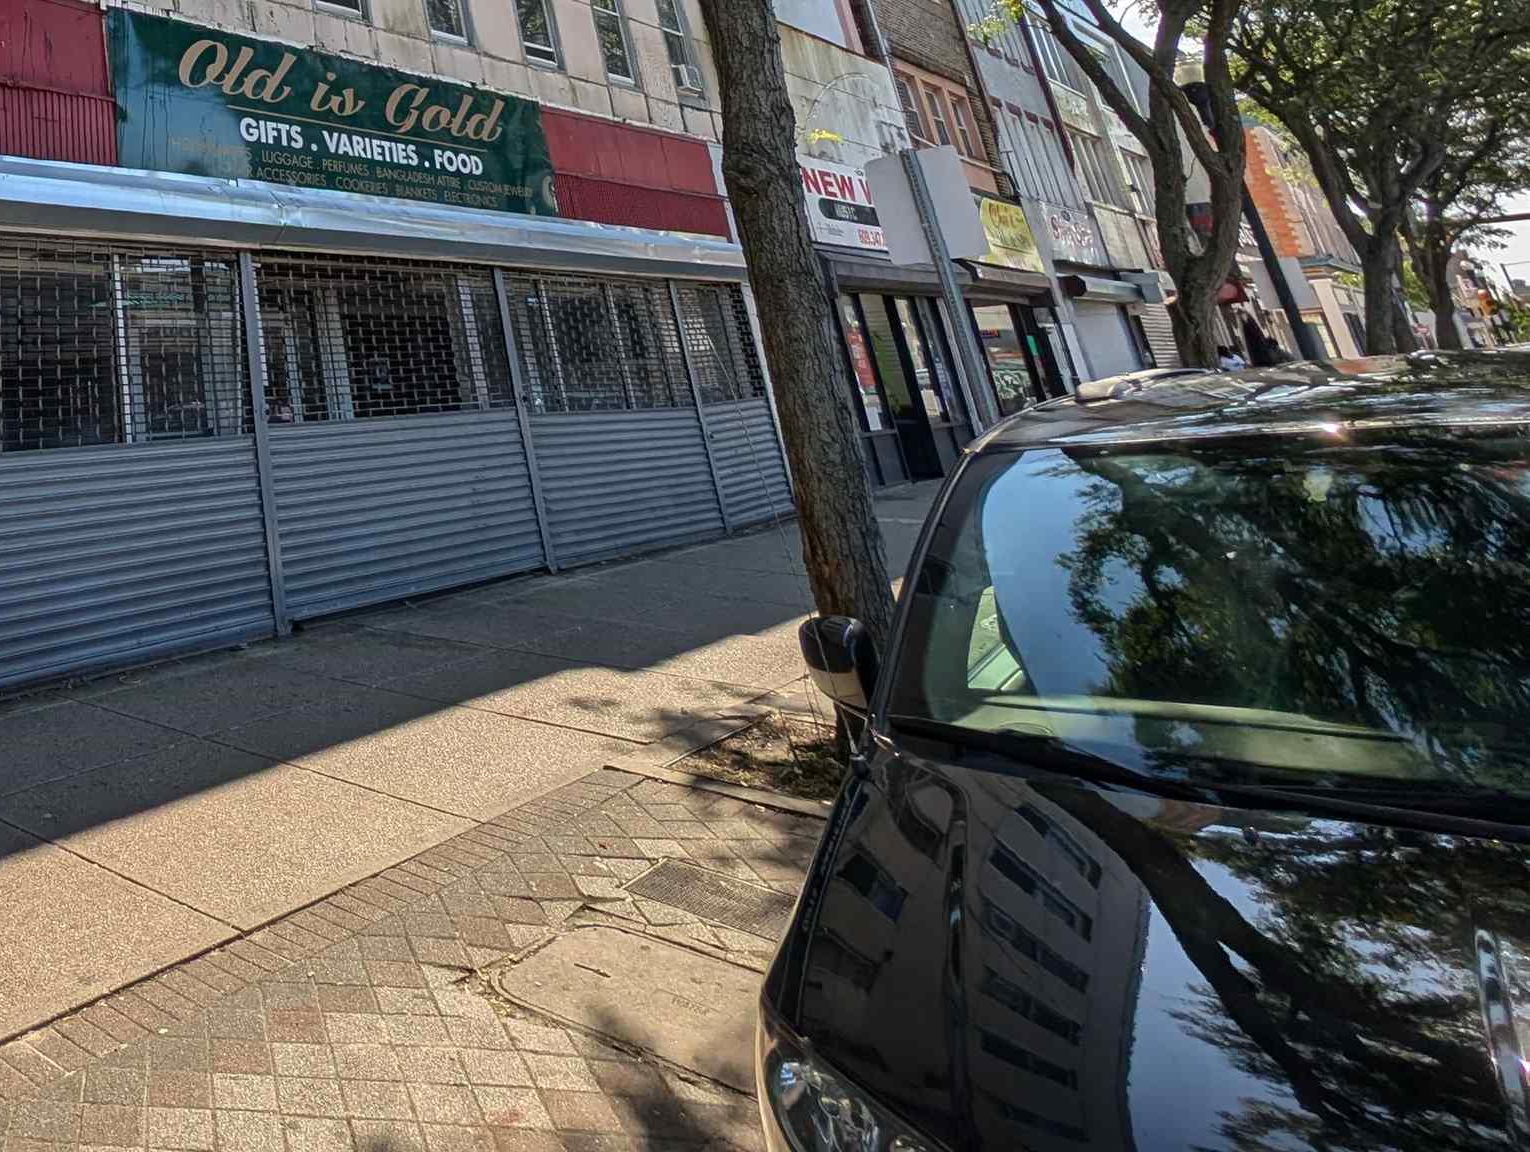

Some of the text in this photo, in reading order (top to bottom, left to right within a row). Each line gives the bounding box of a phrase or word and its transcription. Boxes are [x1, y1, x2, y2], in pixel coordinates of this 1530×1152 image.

[178, 39, 506, 142] Old is Gold
[239, 117, 304, 149] GIFTS
[322, 129, 419, 167] VARIETIES
[433, 148, 484, 176] FOOD
[261, 150, 313, 169] LUGGAGE
[322, 158, 369, 177] PERFUMES
[256, 168, 327, 186] ACCESSORIES
[801, 166, 856, 202] NEW
